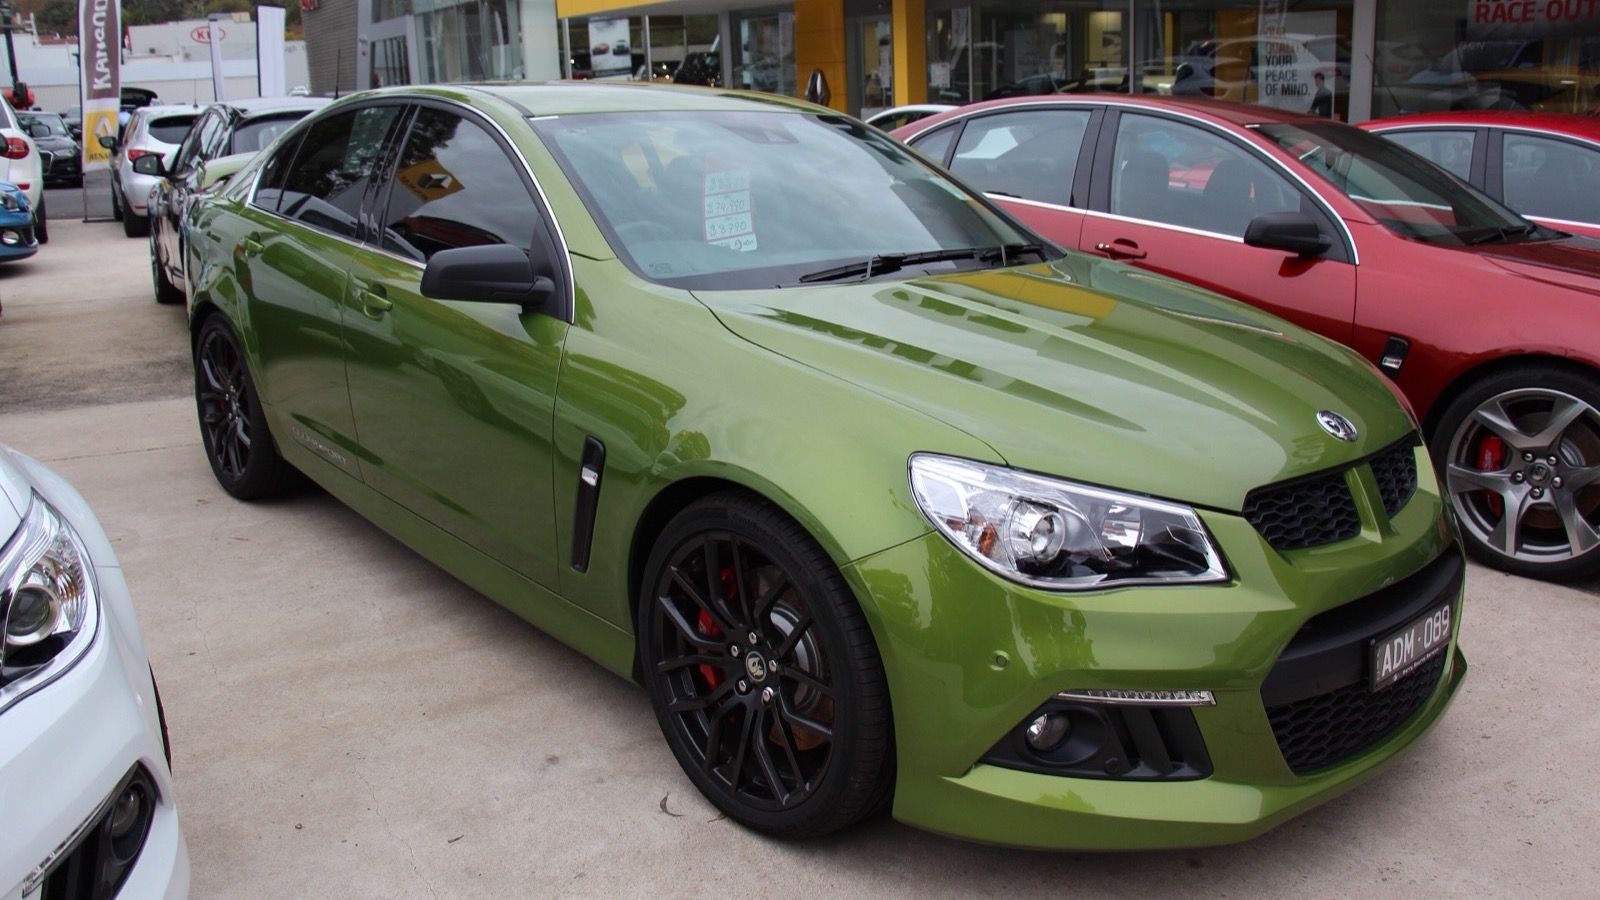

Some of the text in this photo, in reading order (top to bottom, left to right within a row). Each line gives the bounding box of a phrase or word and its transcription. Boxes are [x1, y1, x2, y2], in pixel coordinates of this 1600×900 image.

[1265, 54, 1293, 67] YOUR
[1265, 69, 1298, 82] PEACE
[1265, 82, 1310, 96] OF MIND.
